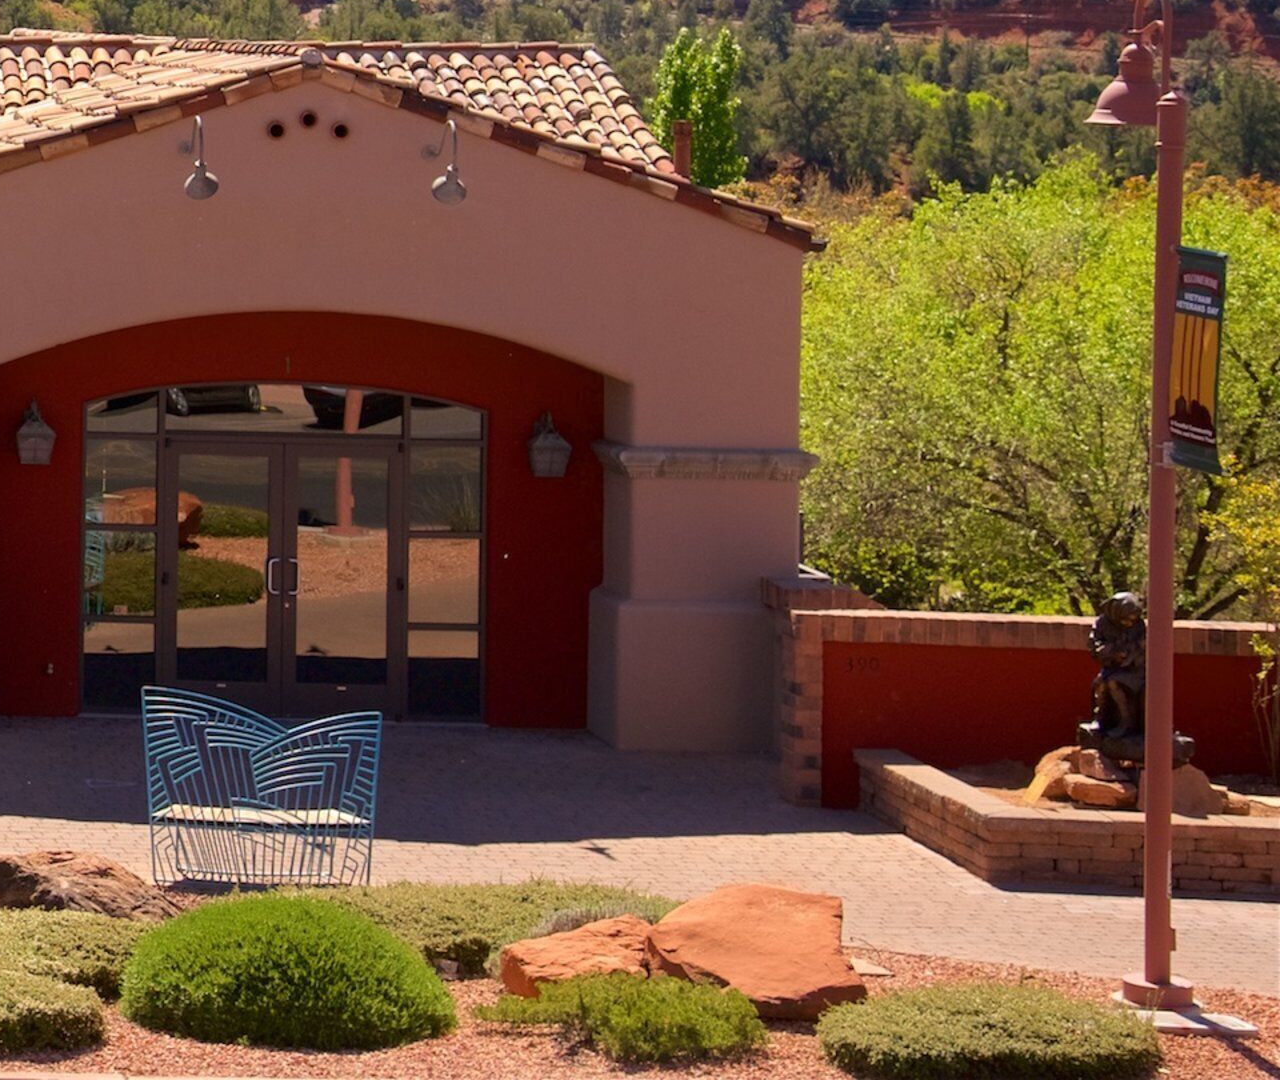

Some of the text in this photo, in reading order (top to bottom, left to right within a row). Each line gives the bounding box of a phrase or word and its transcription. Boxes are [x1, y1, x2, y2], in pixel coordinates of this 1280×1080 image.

[1183, 292, 1212, 304] VIETNAM
[1207, 306, 1220, 316] DAY
[843, 656, 880, 675] 390
